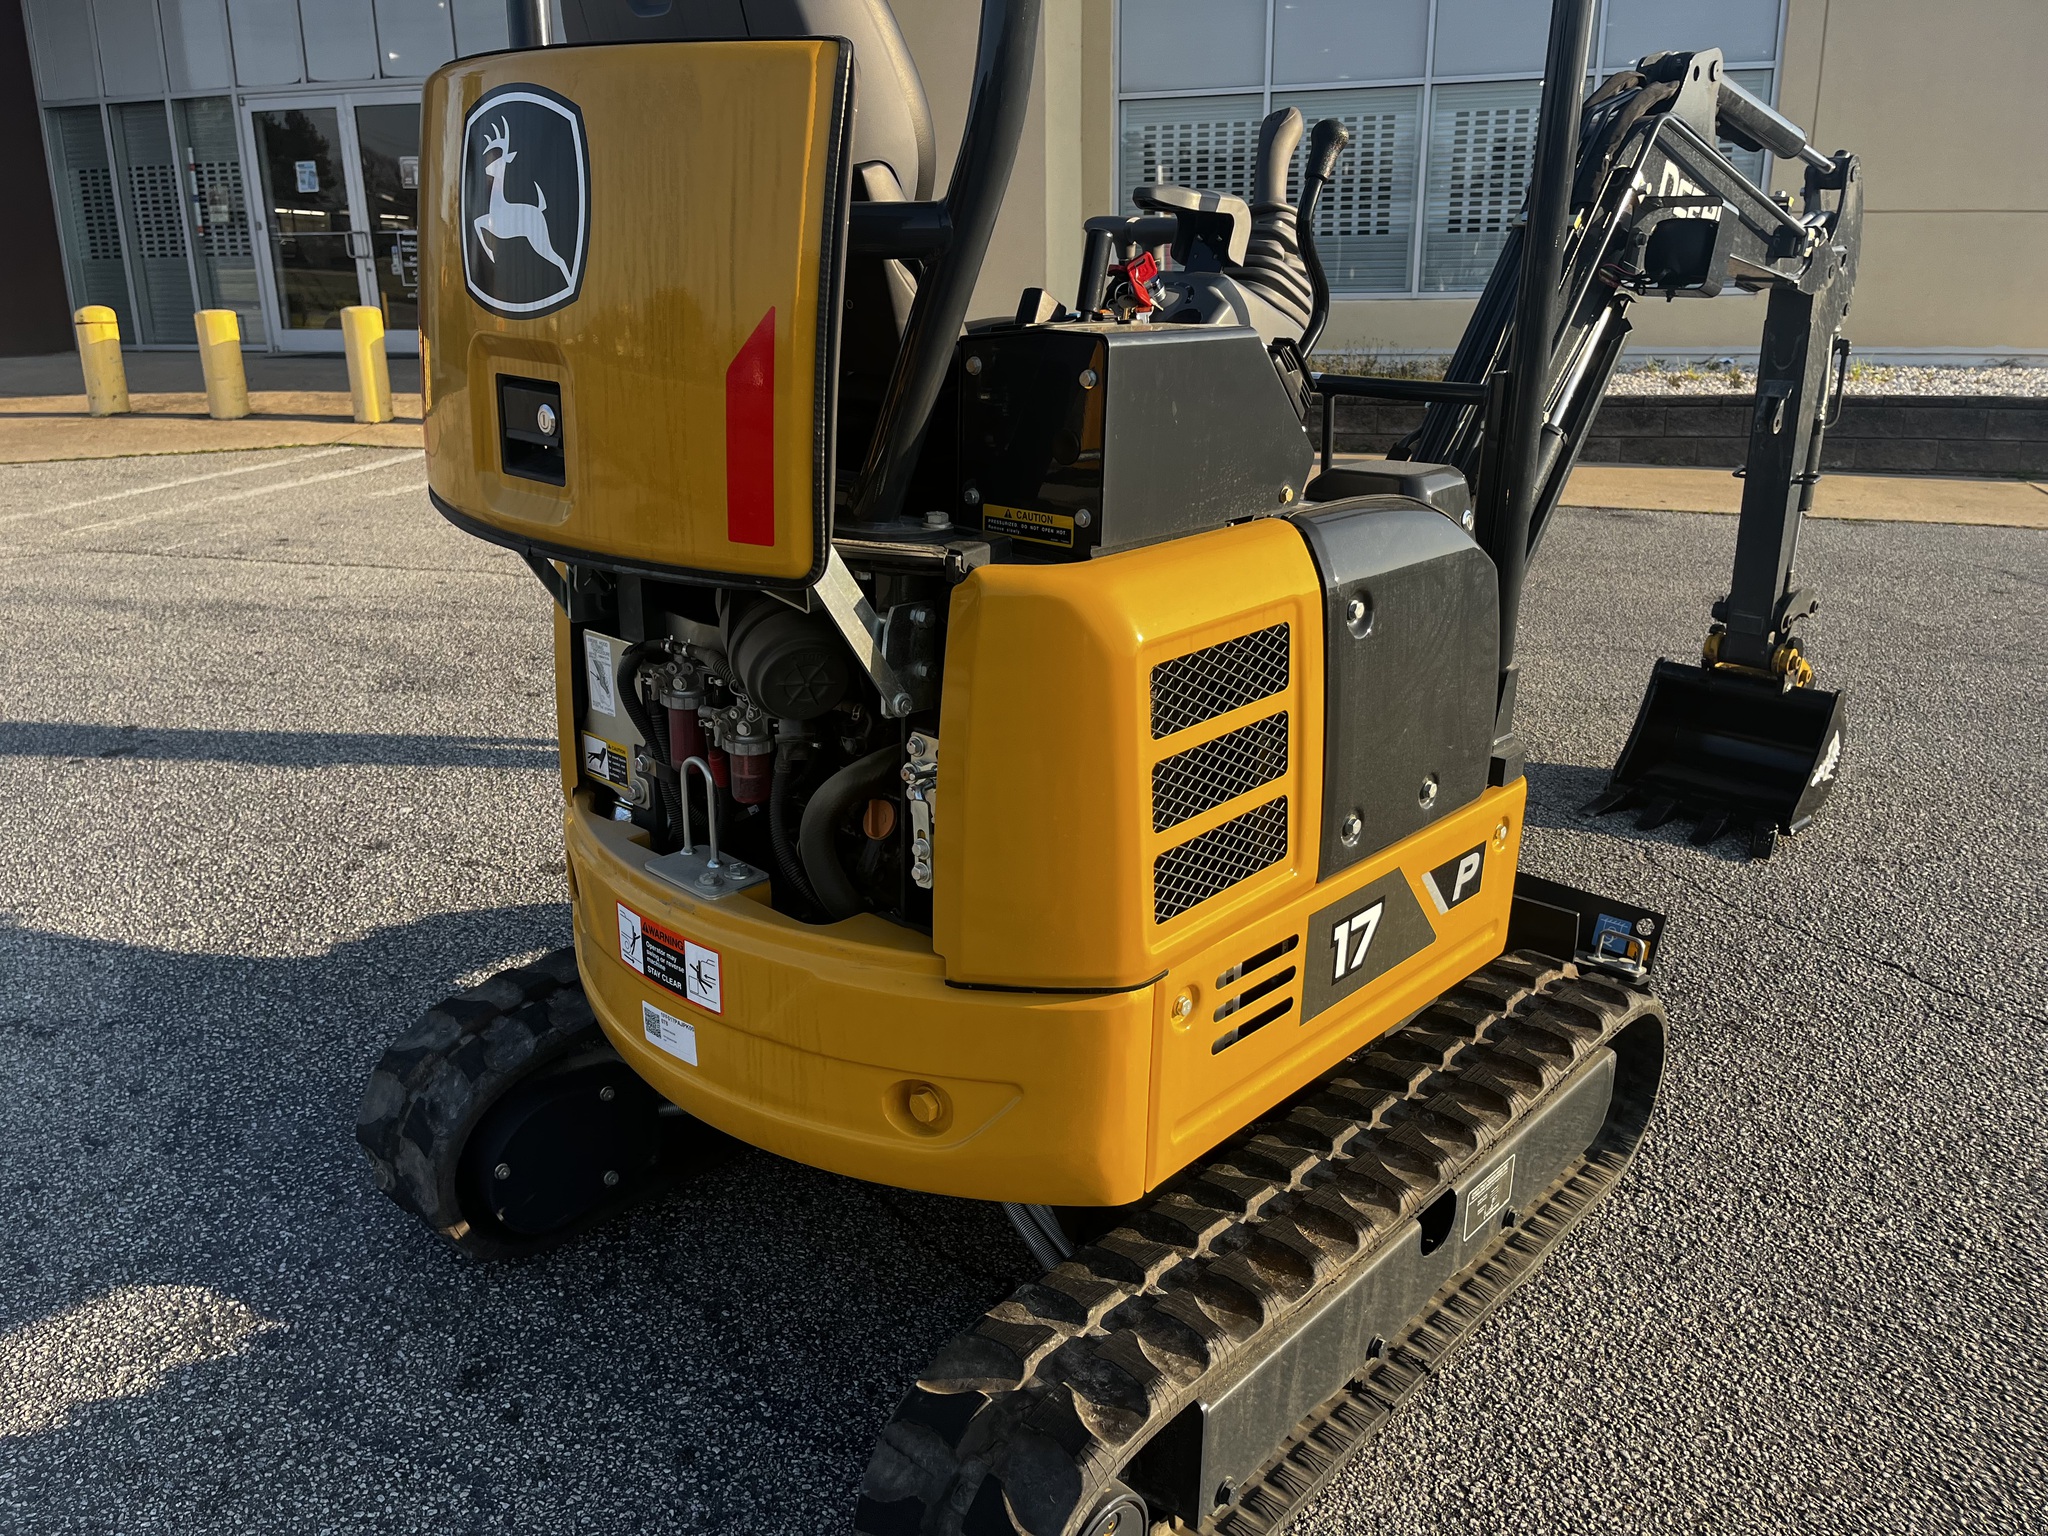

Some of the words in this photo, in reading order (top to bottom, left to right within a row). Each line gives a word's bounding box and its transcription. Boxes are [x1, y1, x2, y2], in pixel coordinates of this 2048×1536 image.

[1016, 511, 1054, 524] CAUTION
[611, 745, 626, 755] CAUTION
[648, 925, 684, 951] WARNING
[1334, 902, 1383, 979] 17
[645, 941, 666, 956] Operator
[666, 951, 678, 963] may
[646, 949, 660, 962] swing
[666, 959, 685, 974] reverse
[646, 957, 666, 971] machine
[647, 965, 661, 979] STAY
[661, 974, 682, 990] CLEAR
